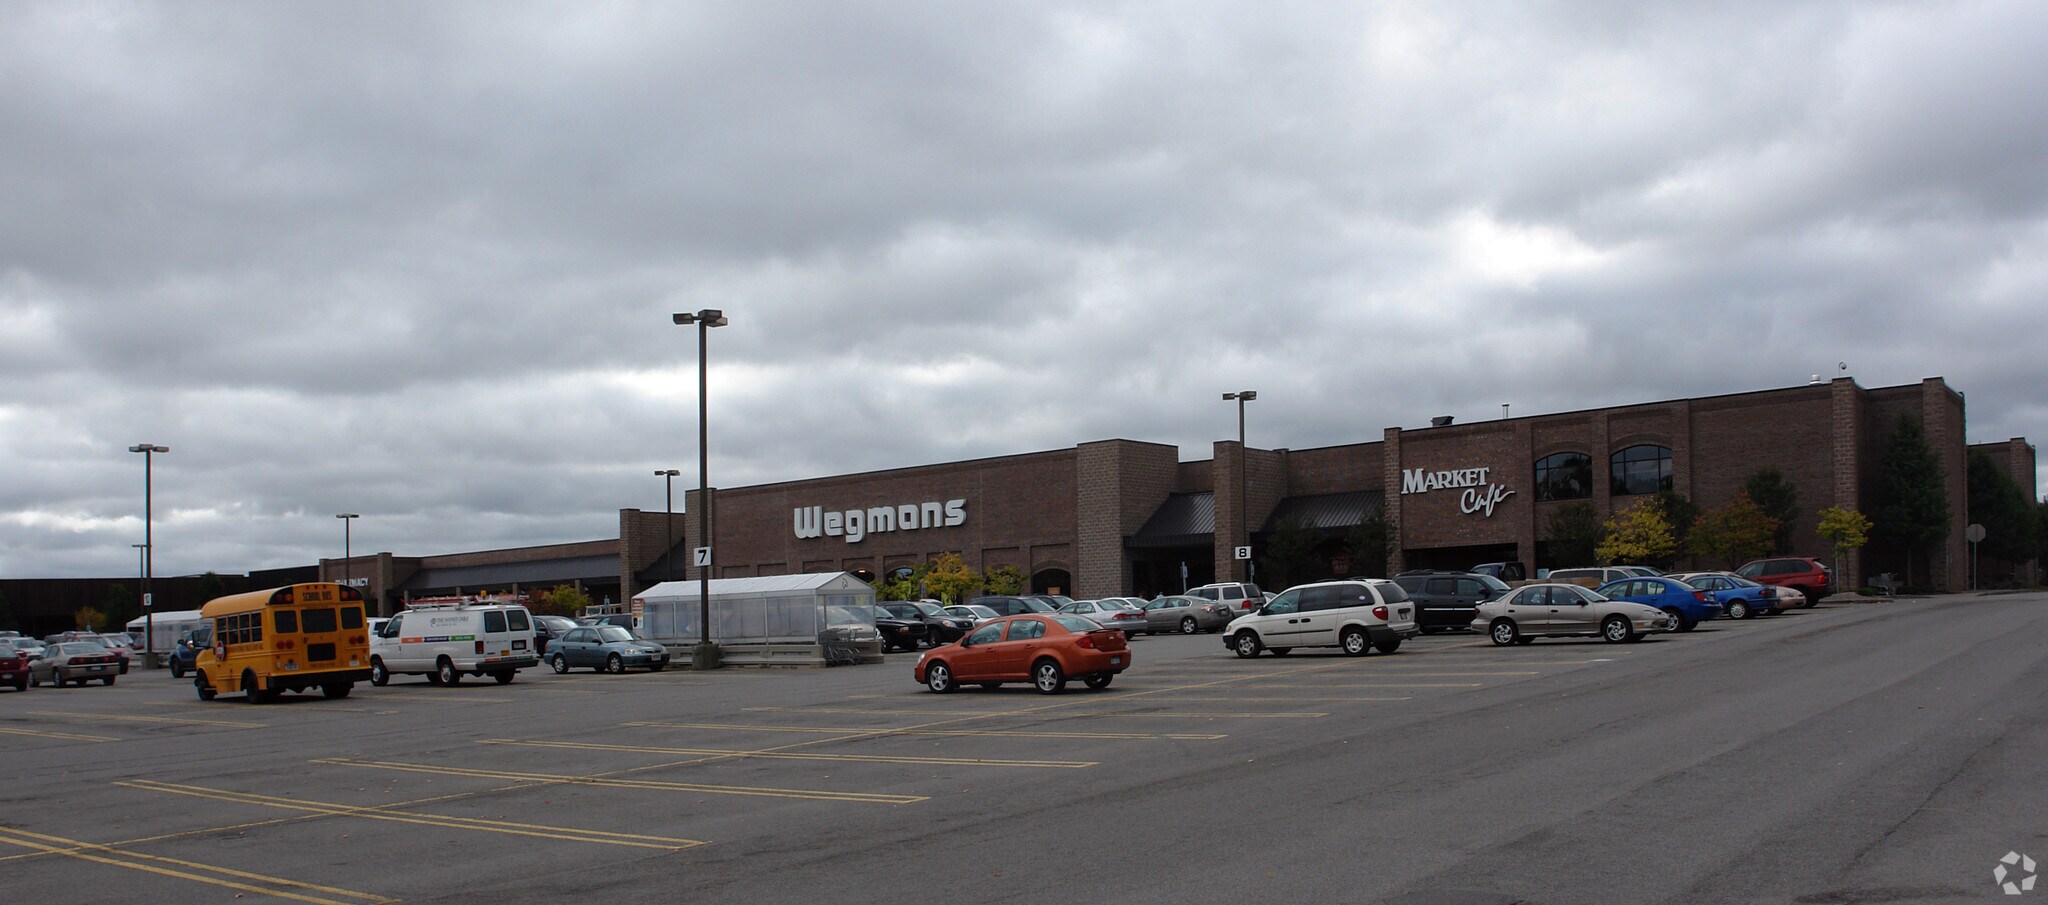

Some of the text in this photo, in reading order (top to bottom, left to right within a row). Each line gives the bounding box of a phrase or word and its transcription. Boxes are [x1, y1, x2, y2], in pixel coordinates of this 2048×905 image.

[1401, 467, 1490, 494] MARKET
[1460, 482, 1515, 517] Café
[794, 498, 967, 543] Wegmans
[698, 549, 706, 563] 7
[1239, 548, 1247, 557] 8
